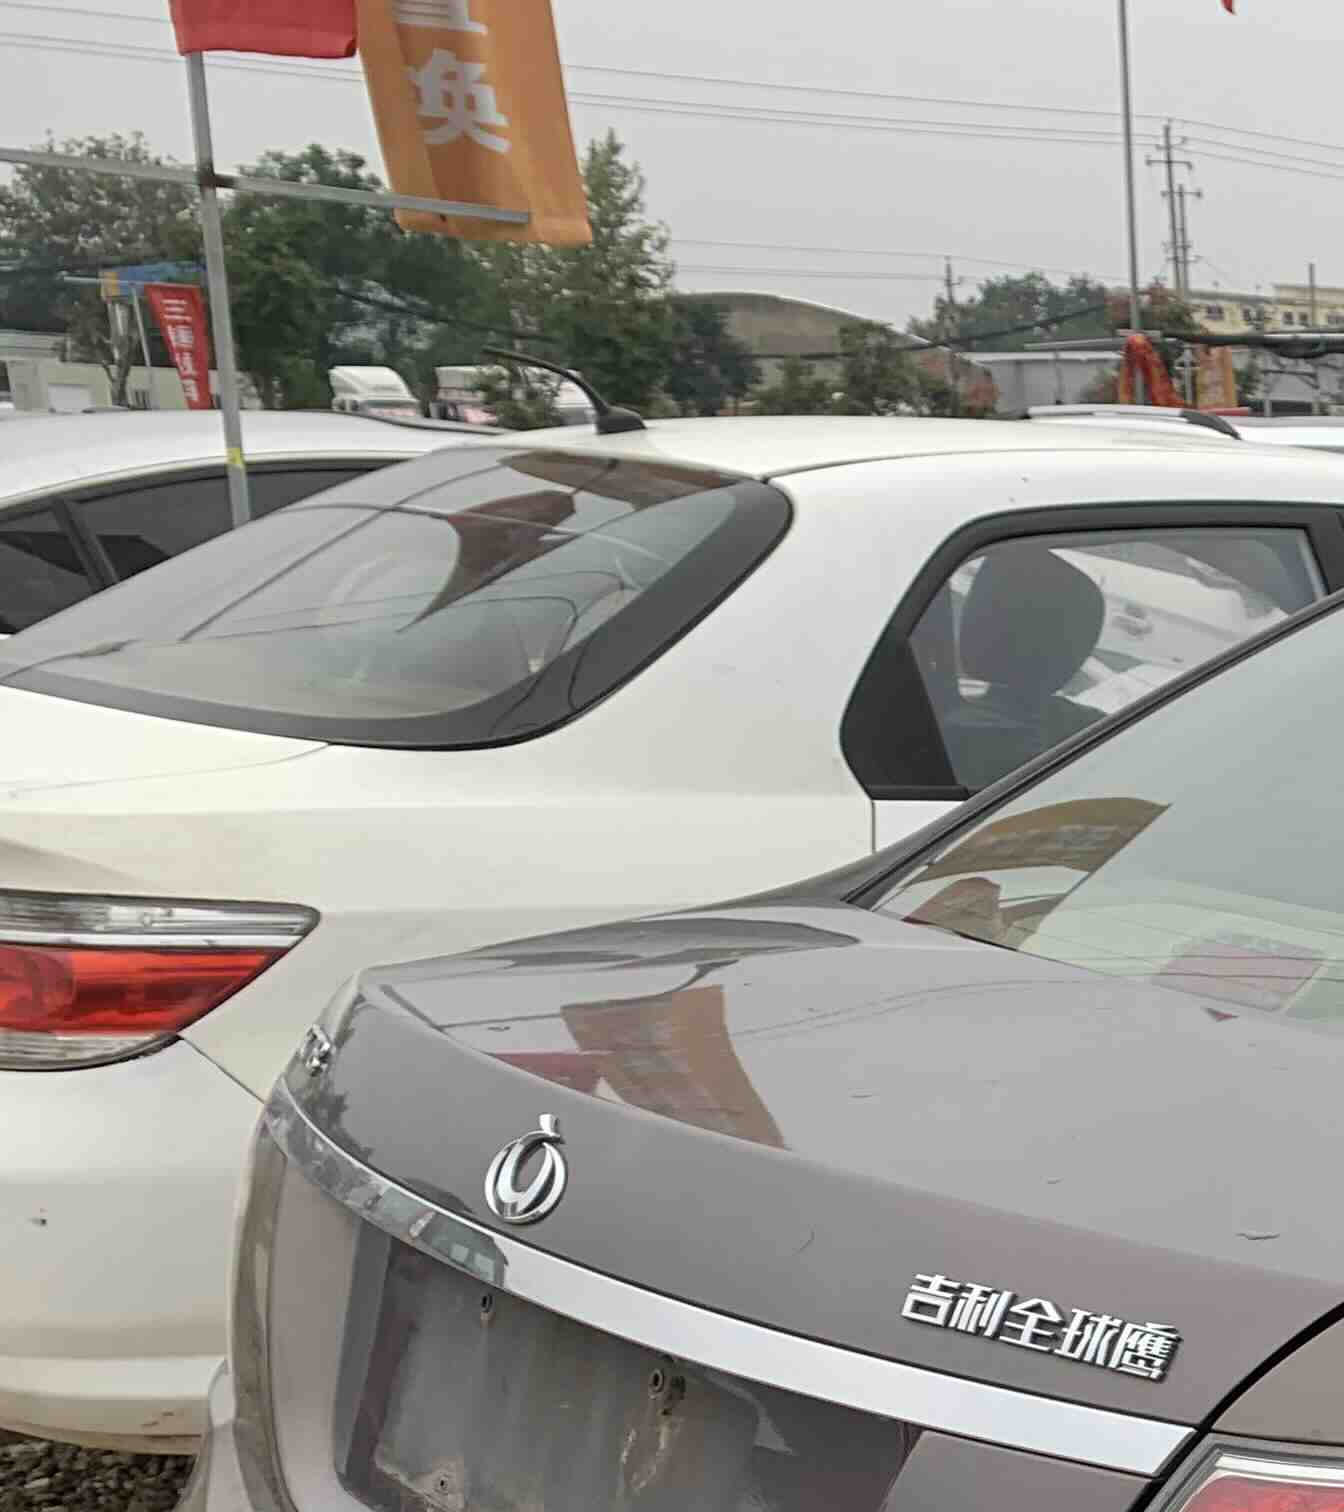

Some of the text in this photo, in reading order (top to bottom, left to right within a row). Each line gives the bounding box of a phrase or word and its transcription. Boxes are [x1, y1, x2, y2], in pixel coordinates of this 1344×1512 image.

[901, 1273, 1179, 1380] 吉利全球鹰
